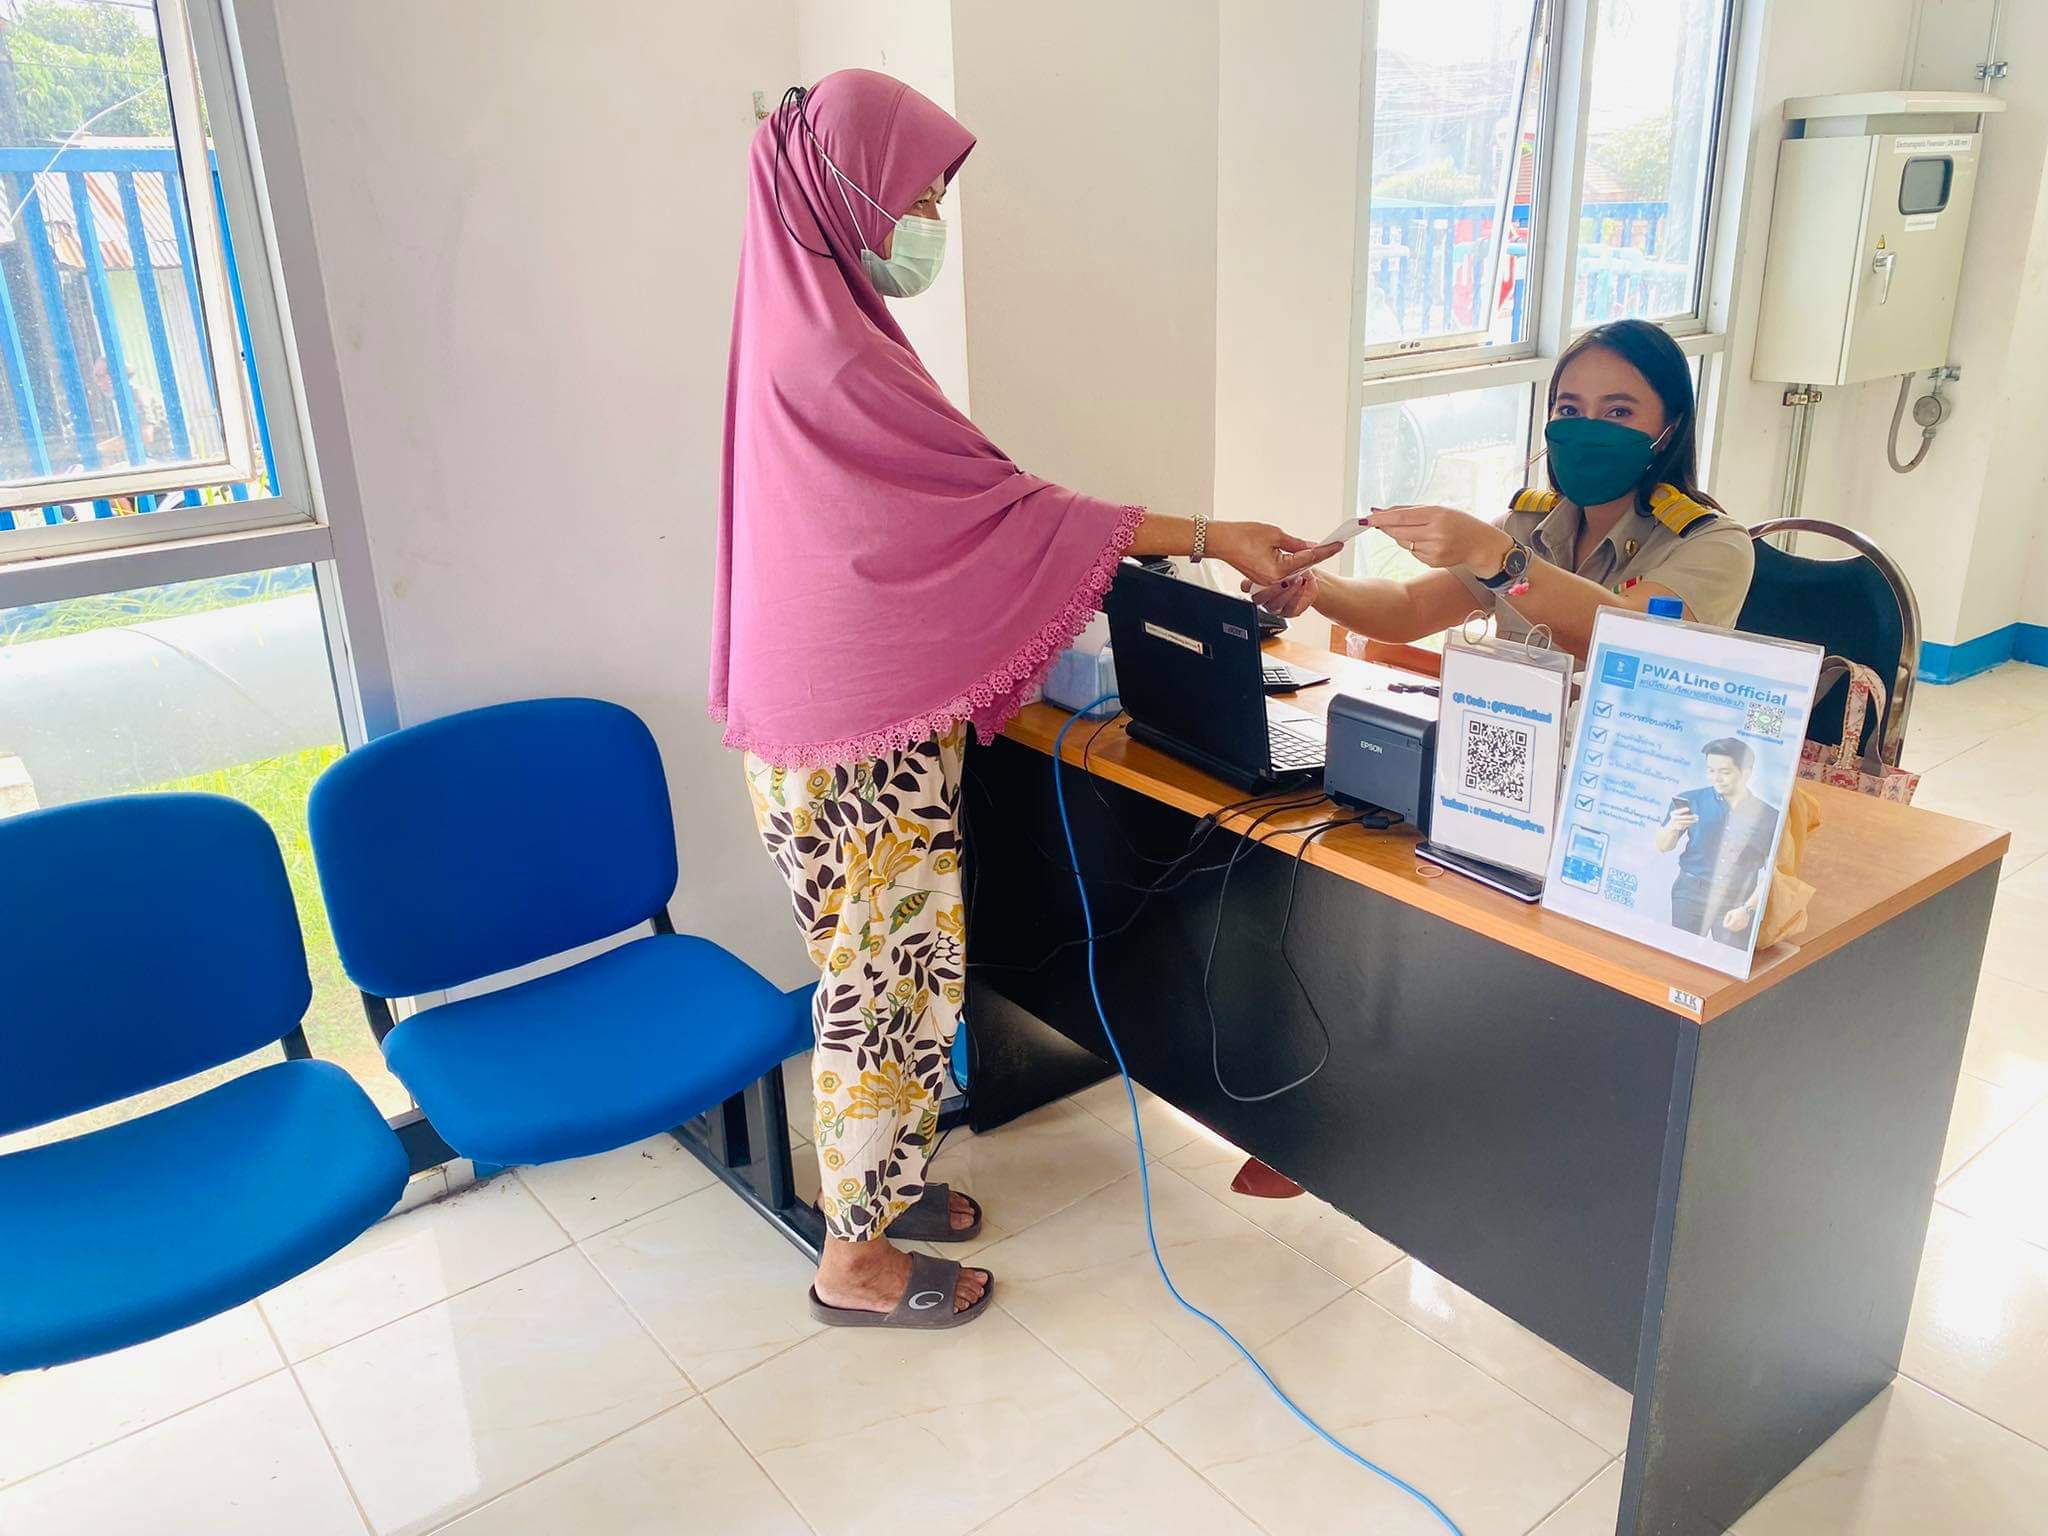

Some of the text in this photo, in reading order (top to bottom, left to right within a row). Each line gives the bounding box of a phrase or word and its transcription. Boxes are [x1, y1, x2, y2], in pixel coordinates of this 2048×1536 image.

[1642, 663, 1681, 682] PWA
[1684, 672, 1720, 690] Line
[1723, 681, 1788, 706] Official
[1360, 740, 1383, 754] EPSON
